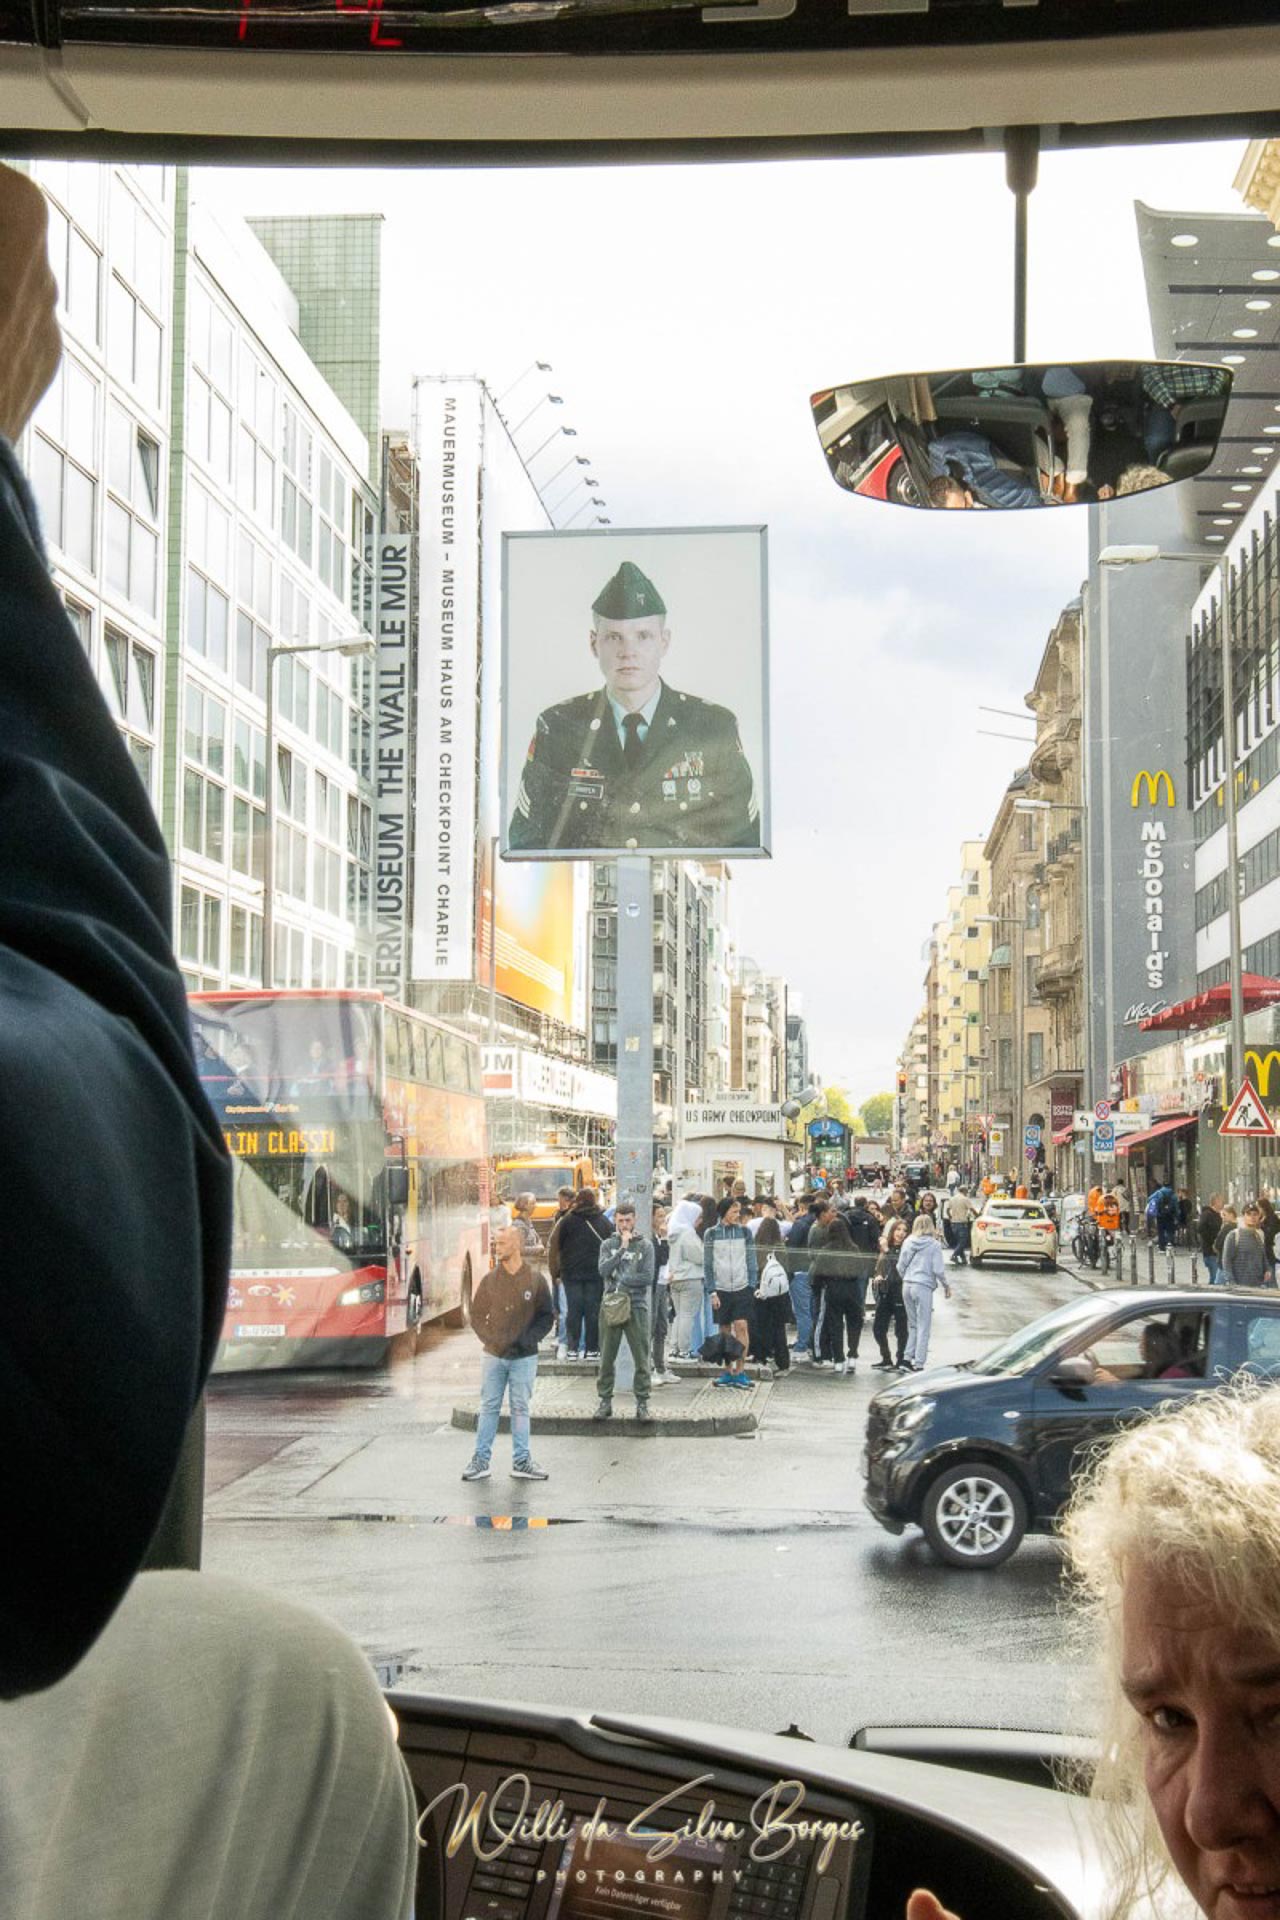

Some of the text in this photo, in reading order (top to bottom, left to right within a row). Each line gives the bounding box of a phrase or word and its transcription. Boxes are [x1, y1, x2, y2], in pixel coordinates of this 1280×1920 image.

[442, 398, 456, 545] MAUERMUSEUM
[441, 569, 454, 650] MUSEUM
[440, 660, 453, 708] HAUS
[440, 717, 452, 743] AM
[376, 544, 407, 1001] UERMUSEUM THE WALL LE MUR
[437, 753, 452, 875] CHECKPOINT
[435, 884, 449, 966] CHARLIE
[1140, 821, 1168, 989] McDonald's
[224, 1131, 259, 1154] LIN
[702, 1109, 726, 1123] ARMY
[729, 1109, 781, 1123] CHECKPOINT
[595, 1886, 610, 1897] Kein
[650, 1896, 683, 1912] verfügbar
